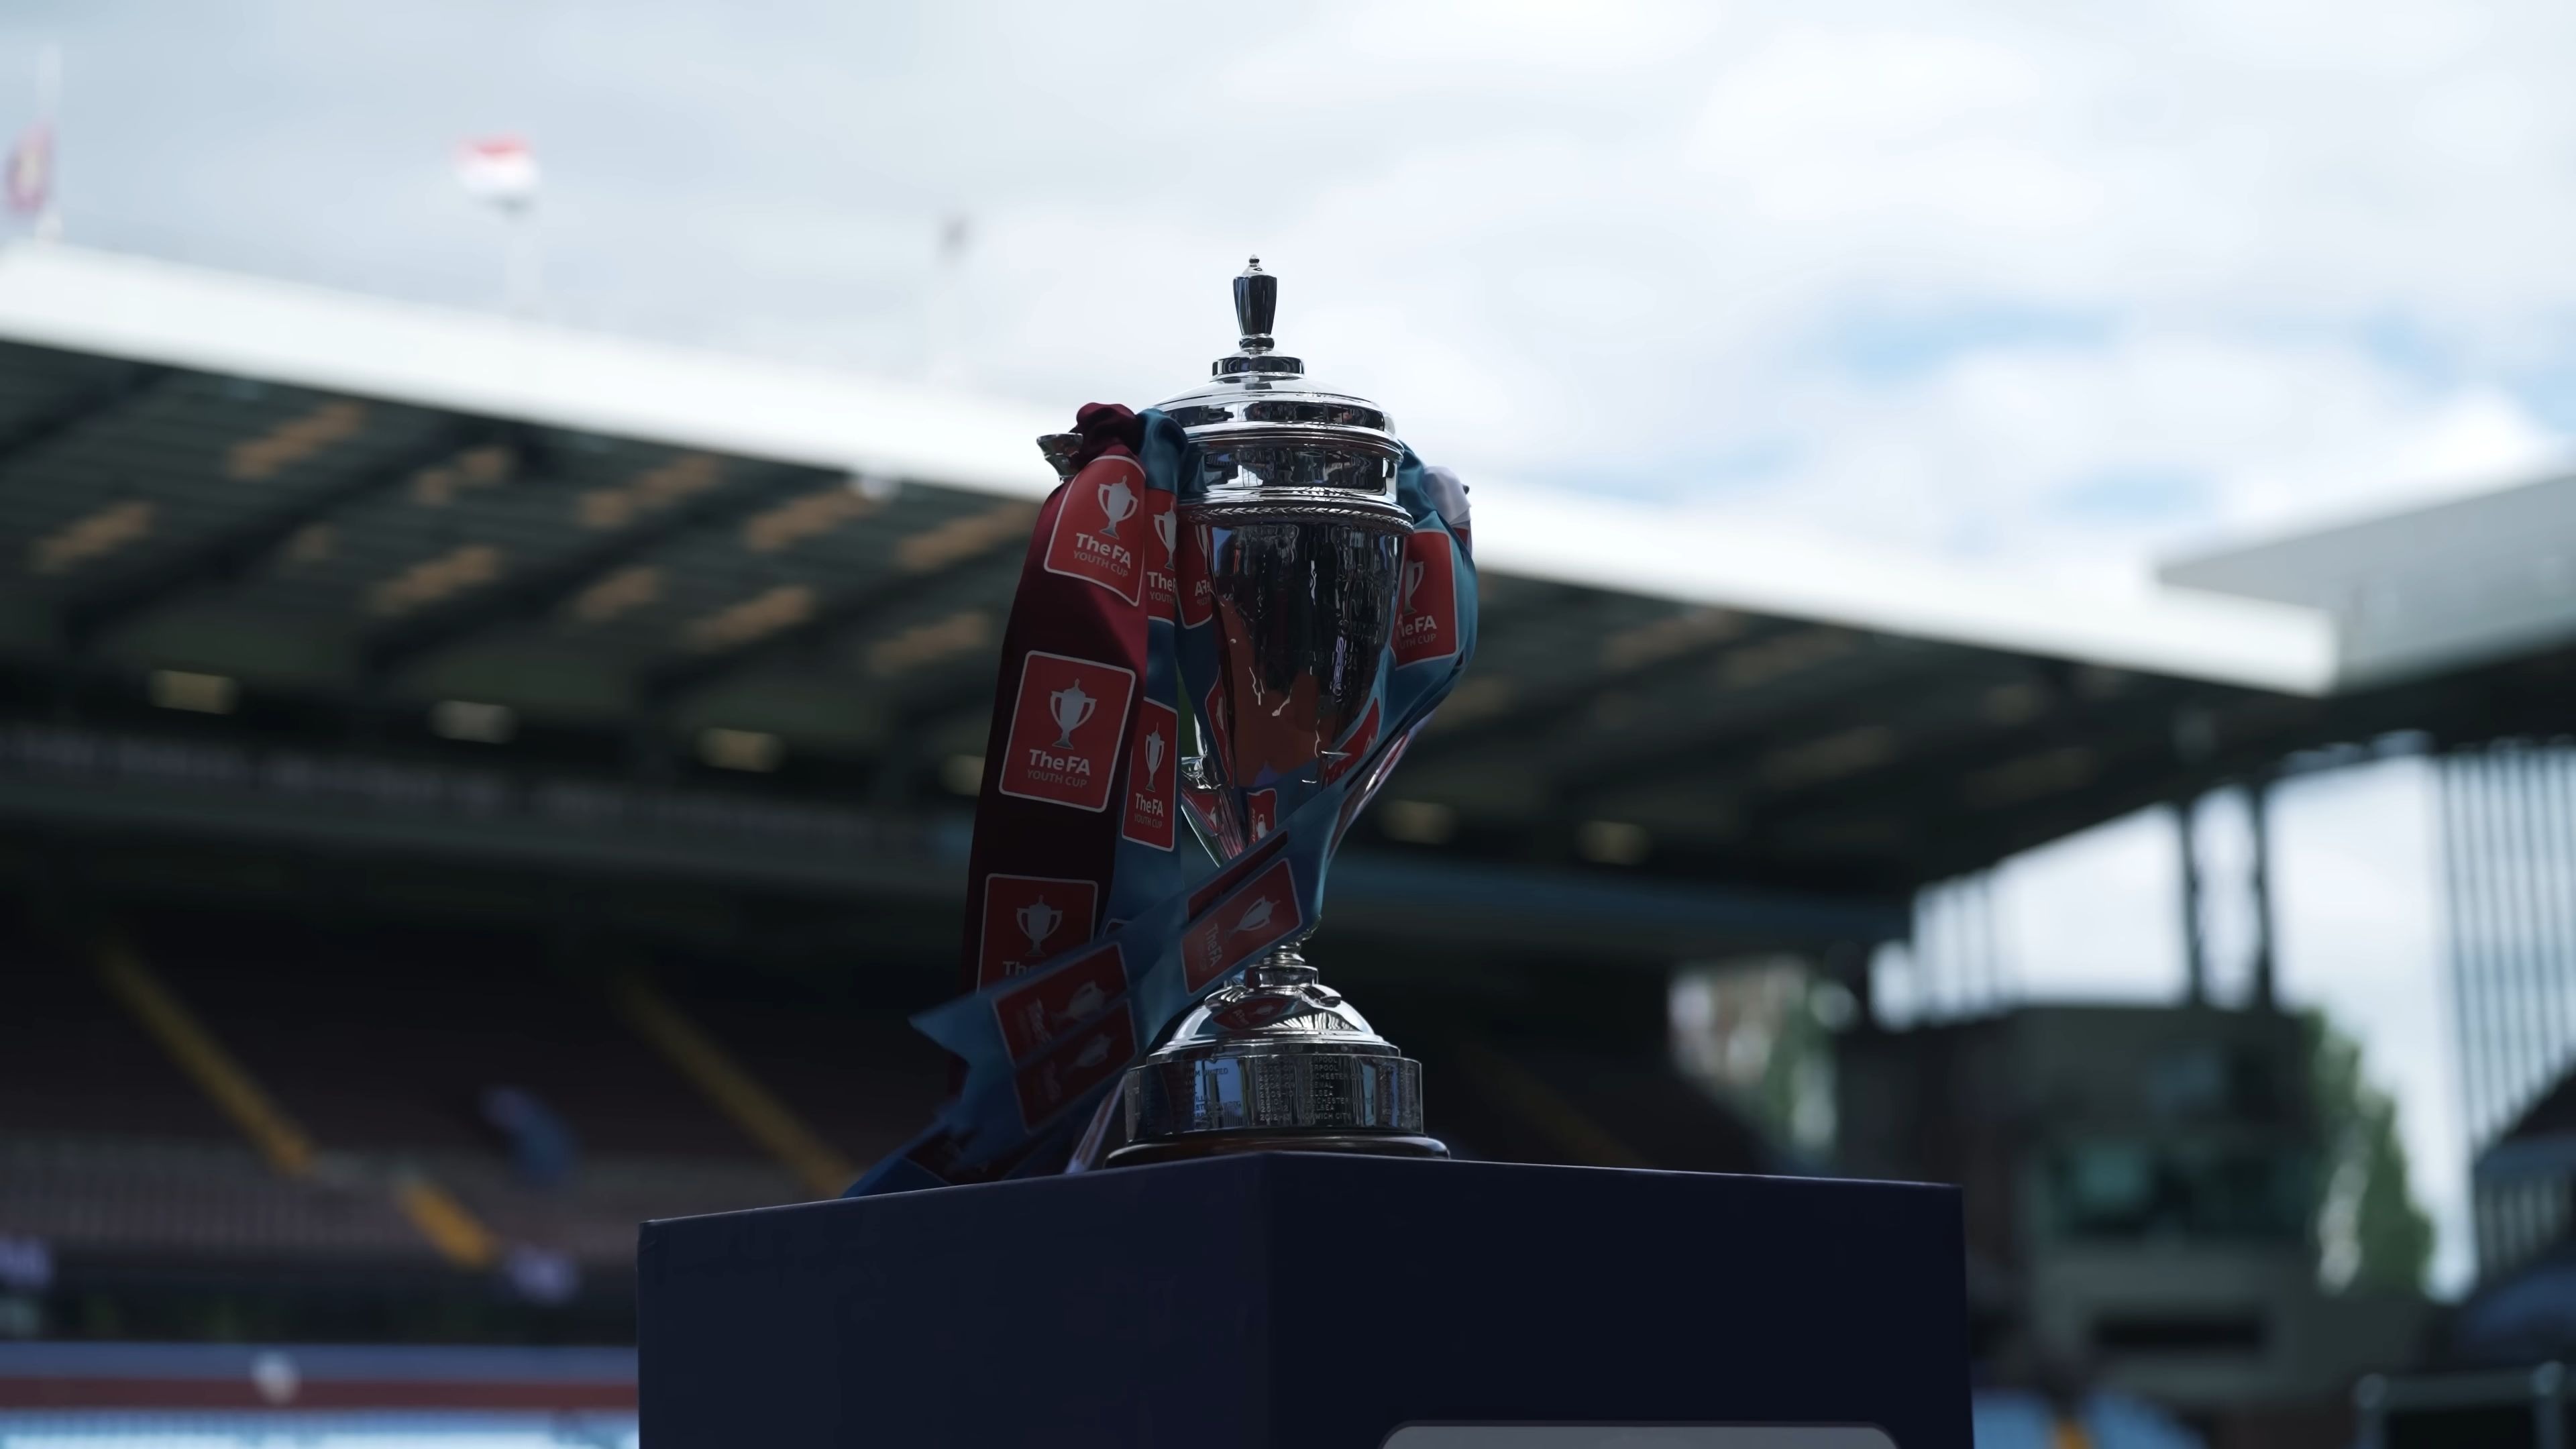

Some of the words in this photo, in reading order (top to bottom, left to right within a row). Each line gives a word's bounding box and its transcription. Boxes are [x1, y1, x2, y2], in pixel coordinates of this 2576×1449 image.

[1073, 550, 1110, 569] YOUTH
[1110, 563, 1129, 578] CUP
[1417, 633, 1436, 645] CUP
[1026, 769, 1063, 784] YOUTH
[1065, 776, 1087, 788] CUP
[1134, 812, 1152, 826] YOUTH
[1152, 818, 1163, 829] CUP
